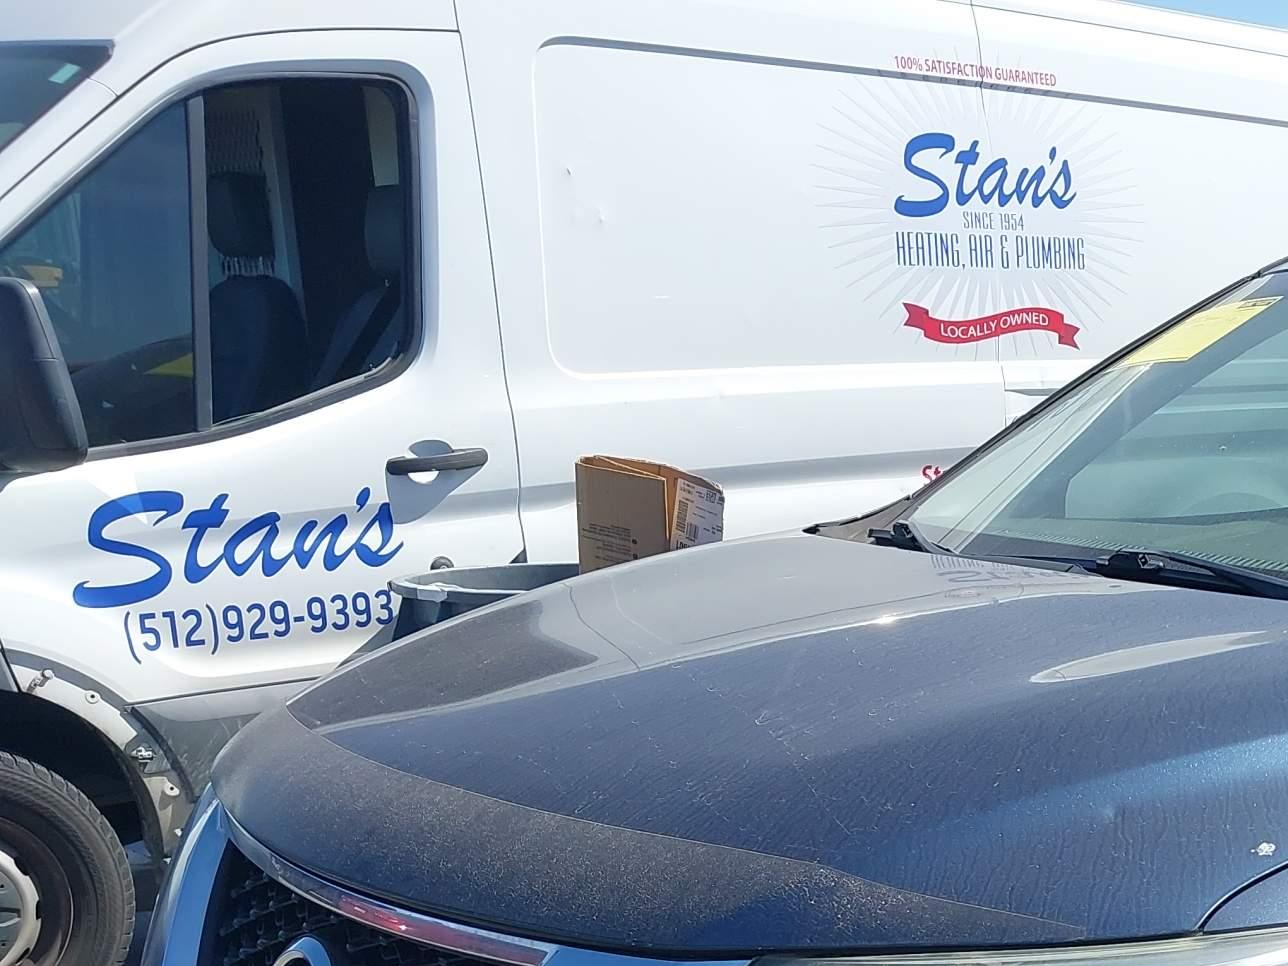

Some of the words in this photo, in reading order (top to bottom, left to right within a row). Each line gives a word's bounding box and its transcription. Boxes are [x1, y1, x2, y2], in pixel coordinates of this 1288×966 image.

[894, 55, 924, 72] 100%
[925, 58, 993, 80] SATISFACTION
[994, 67, 1057, 87] GUARANTEED
[894, 132, 1077, 218] Stan's
[963, 211, 995, 230] SINCE
[1000, 213, 1025, 231] 1954
[895, 231, 966, 270] HEATING,
[968, 234, 994, 269] AIR
[1000, 235, 1010, 269] &
[1016, 235, 1086, 270] PLUMBING
[940, 320, 998, 338] LOCALLY
[1000, 312, 1049, 329] OWNED
[72, 487, 404, 609] Stan's
[123, 589, 394, 665] (512)929-9393
